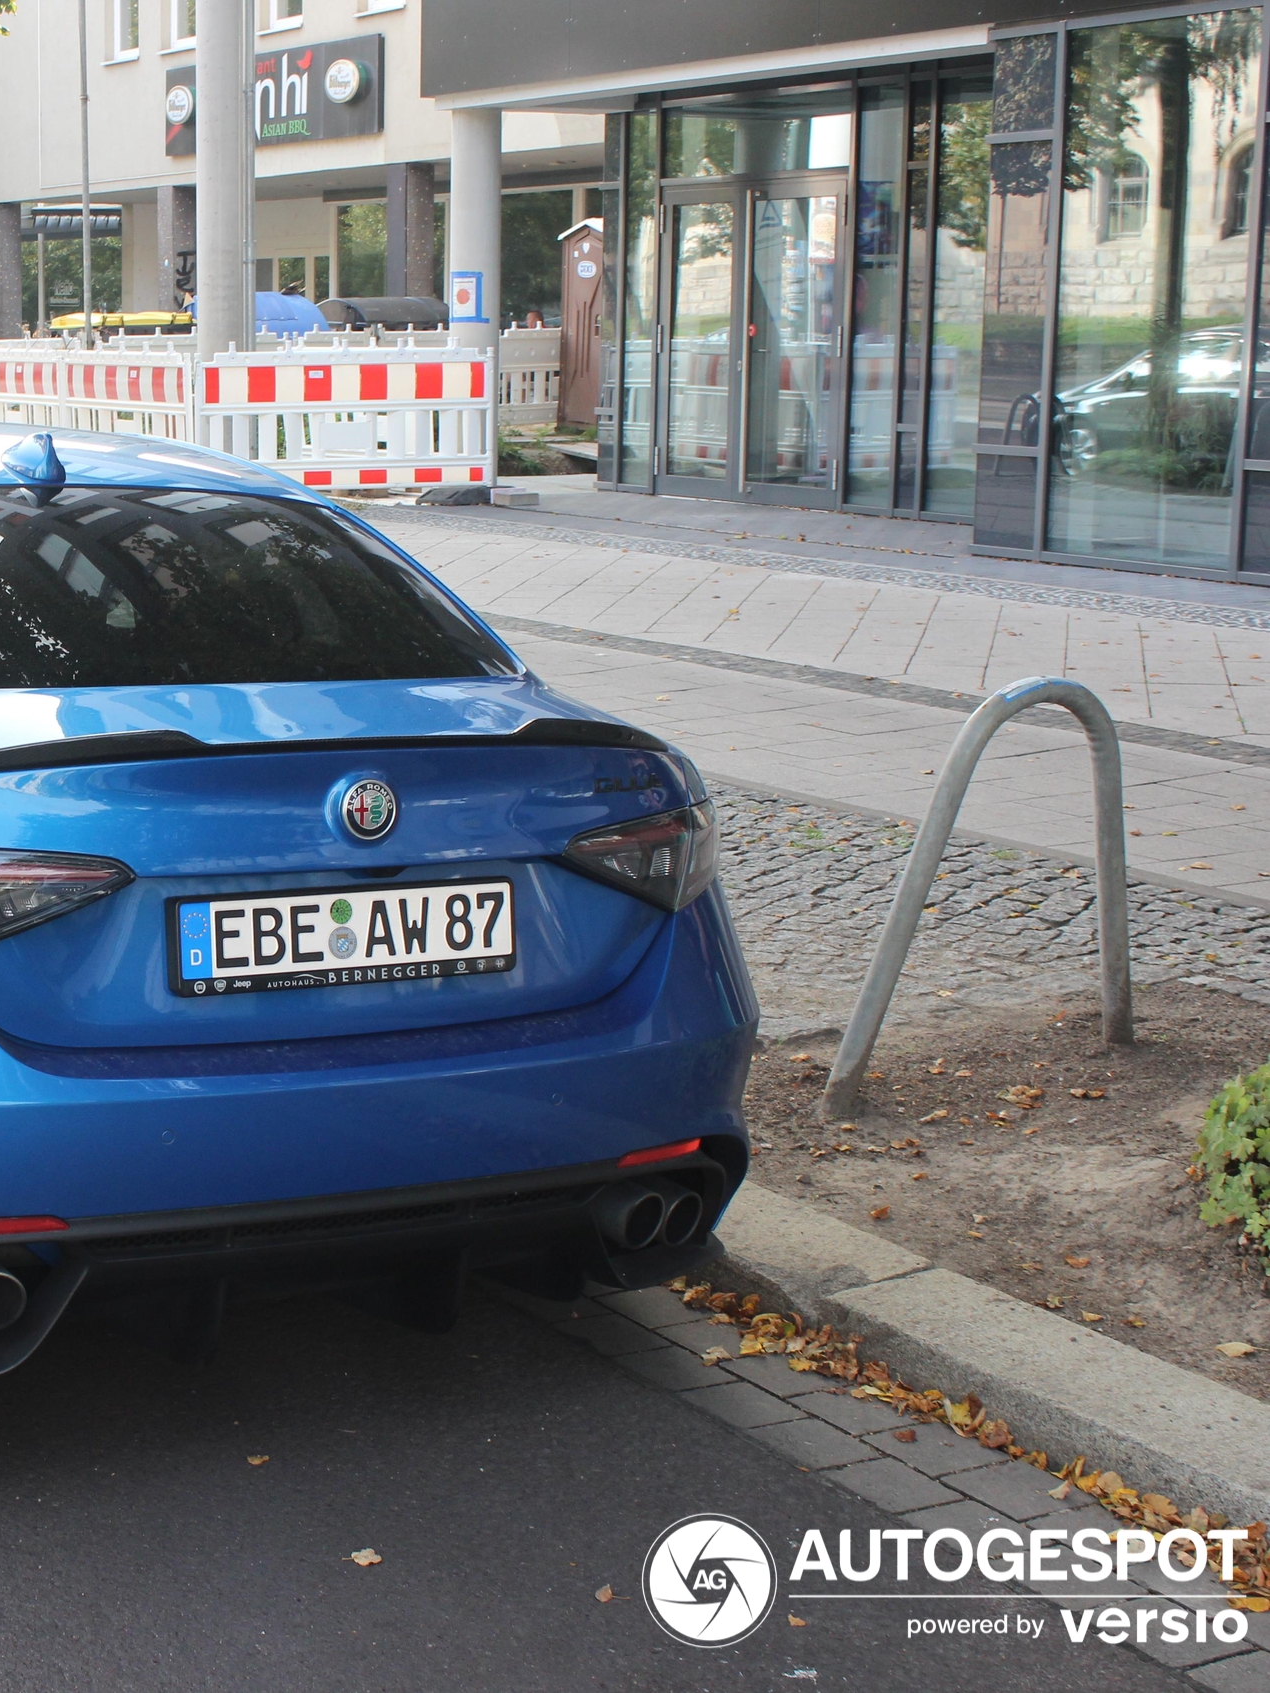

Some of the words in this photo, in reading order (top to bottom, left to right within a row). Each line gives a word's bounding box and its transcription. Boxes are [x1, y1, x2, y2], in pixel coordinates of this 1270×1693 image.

[281, 53, 308, 117] hi
[262, 122, 287, 138] ASIAN
[288, 119, 311, 136] BBQ
[347, 787, 364, 811] ALFA
[366, 783, 393, 810] ROMEO
[190, 949, 203, 966] D
[214, 905, 324, 969] EBE
[364, 897, 429, 958] AW
[445, 892, 504, 951] 87
[232, 979, 252, 989] Jeep
[328, 964, 440, 984] BERNEGGER
